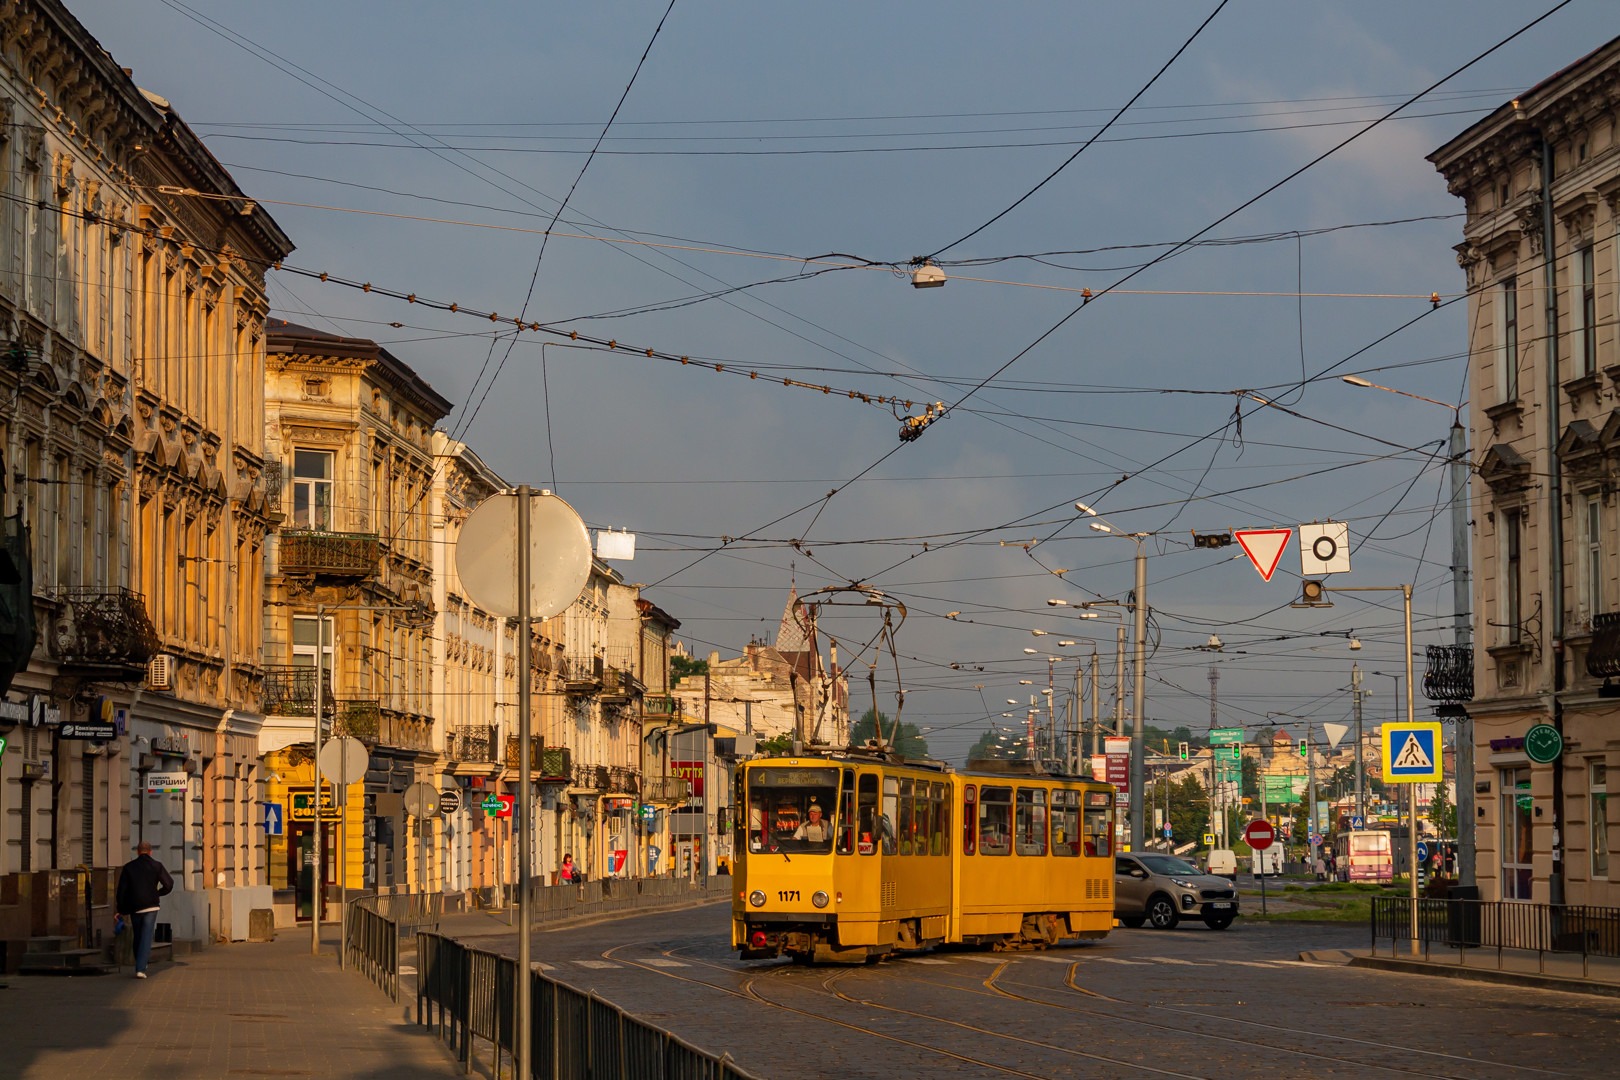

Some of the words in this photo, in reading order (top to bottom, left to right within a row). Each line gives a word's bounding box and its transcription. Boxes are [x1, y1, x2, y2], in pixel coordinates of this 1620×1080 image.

[671, 767, 703, 778] ЗУТТЯ
[149, 778, 185, 786] ПЕРШИЙ
[758, 772, 766, 785] 4
[778, 891, 800, 902] 1171
